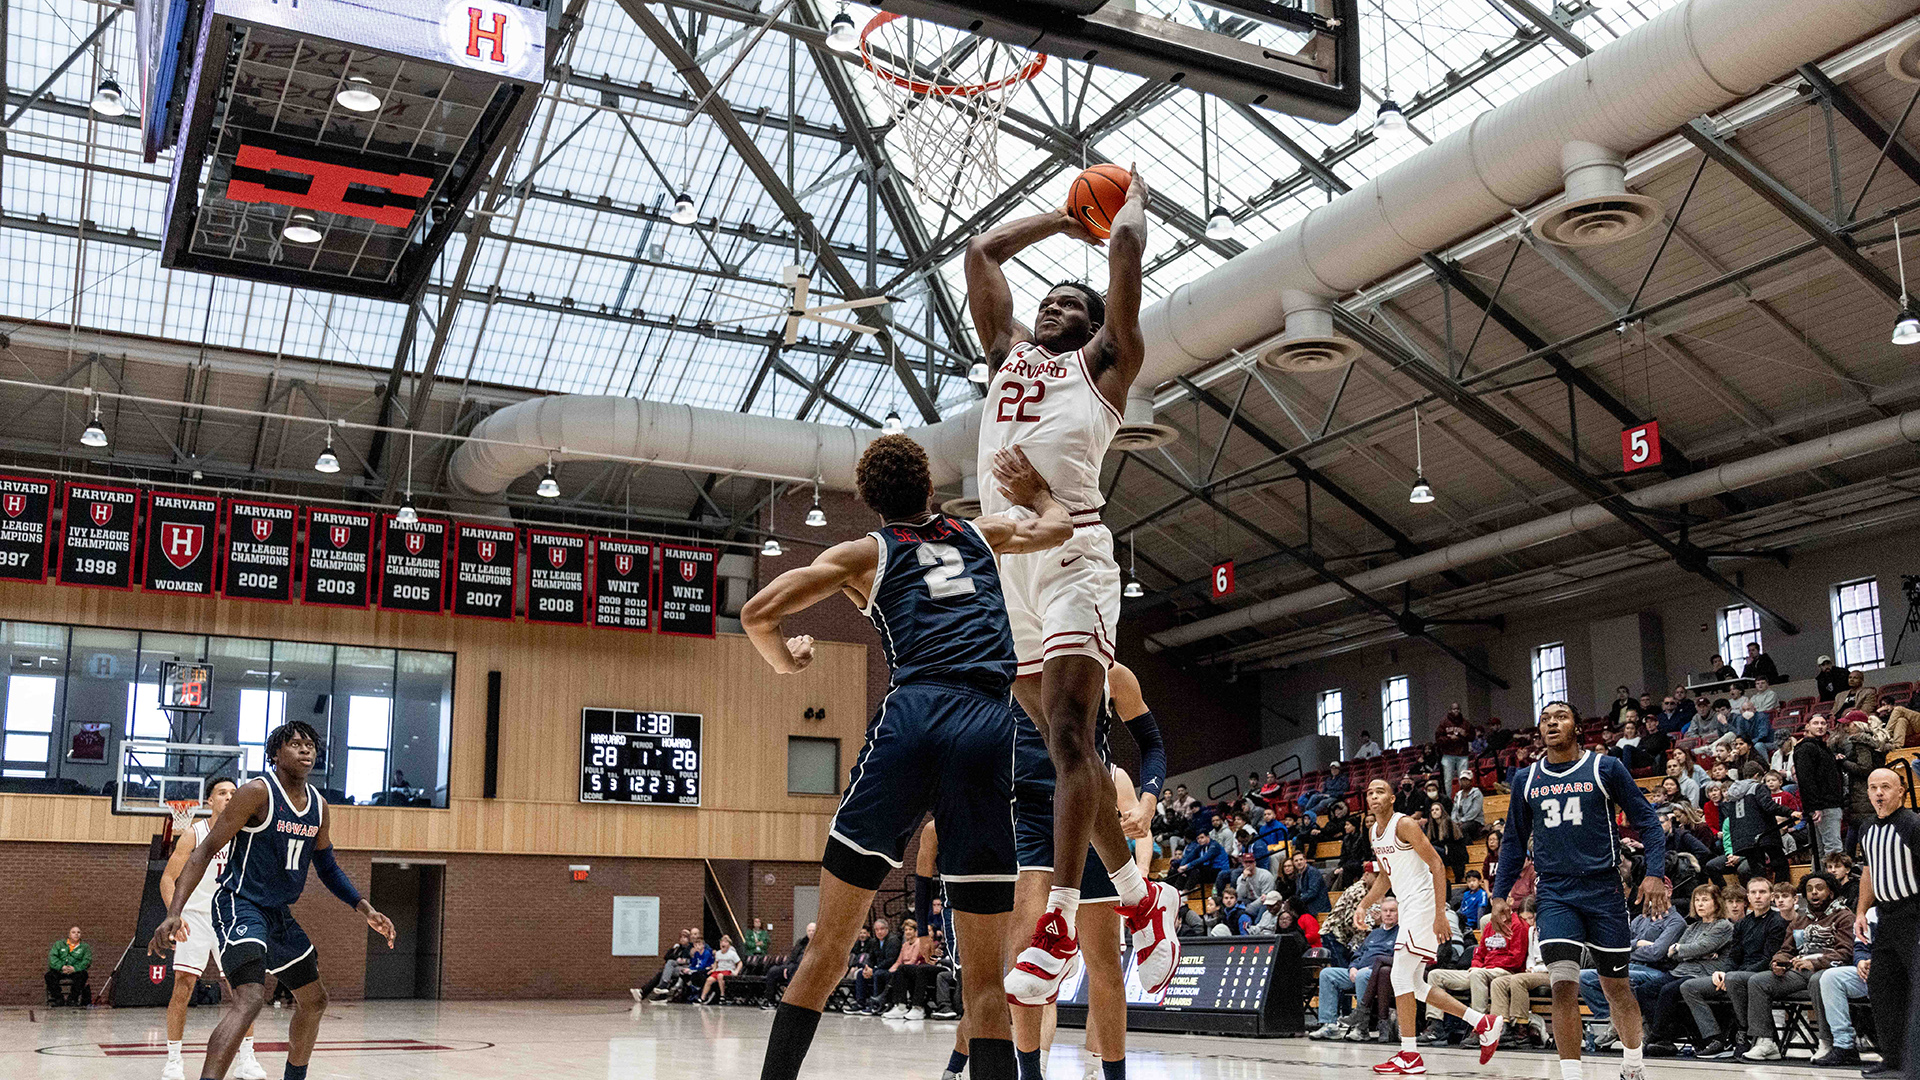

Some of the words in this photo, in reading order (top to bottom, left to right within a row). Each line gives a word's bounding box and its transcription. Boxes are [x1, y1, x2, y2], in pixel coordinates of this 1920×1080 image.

[466, 7, 506, 63] H
[996, 380, 1046, 423] 22
[1631, 428, 1649, 463] 5
[0, 481, 48, 494] RVARD
[72, 487, 134, 503] HARVARD
[8, 496, 21, 511] H
[96, 503, 108, 518] H
[155, 496, 215, 512] HARVARD
[234, 505, 292, 520] HARVARD
[314, 512, 368, 527] HARVARD
[2, 520, 43, 533] LEAGUE
[70, 526, 89, 538] IVY
[91, 528, 130, 542] LEAGUE
[256, 521, 269, 536] H
[389, 520, 443, 534] HARVARD
[171, 527, 194, 556] H
[335, 528, 346, 543] H
[410, 535, 420, 550] H
[462, 528, 514, 542] HARVARD
[533, 534, 584, 548] HARVARD
[68, 537, 129, 552] CHAMPIONS
[232, 542, 250, 554] IVY
[252, 544, 289, 556] LEAGUE
[482, 543, 492, 557] H
[600, 542, 648, 555] HARVARD
[231, 552, 289, 566] CHAMPIONS
[311, 548, 328, 559] IVY
[330, 551, 366, 563] LEAGUE
[388, 554, 404, 565] IVY
[405, 558, 440, 569] LEAGUE
[553, 550, 562, 563] H
[665, 548, 712, 562] HARVARD
[76, 557, 117, 575] 1998
[310, 558, 366, 573] CHAMPIONS
[460, 562, 476, 572] IVY
[478, 564, 512, 577] LEAGUE
[620, 556, 629, 570] H
[684, 562, 694, 576] H
[386, 565, 440, 579] CHAMPIONS
[532, 569, 548, 579] IVY
[550, 570, 582, 582] LEAGUE
[916, 542, 976, 600] 2
[155, 579, 203, 593] WOMEN
[238, 573, 278, 590] 2002
[317, 578, 356, 595] 2003
[459, 572, 512, 586] CHAMPIONS
[532, 578, 582, 592] CHAMPIONS
[607, 579, 640, 594] WNIT
[1616, 567, 1628, 592] 6
[393, 584, 430, 600] 2005
[466, 591, 502, 608] 2007
[672, 585, 704, 600] WNIT
[539, 598, 574, 612] 2008
[598, 614, 620, 625] 2014
[636, 714, 671, 734] 1:38
[590, 734, 626, 746] HARVARD
[662, 738, 692, 749] HOWARD
[592, 746, 618, 766] 28
[643, 751, 648, 766] 1
[672, 750, 697, 770] 28
[584, 766, 604, 774] FOULS
[624, 768, 646, 776] PLAYER
[647, 769, 662, 777] FOUL
[679, 771, 698, 779] FOULS
[591, 774, 602, 790] 5
[610, 778, 618, 790] 3
[630, 776, 645, 792] 12
[649, 776, 660, 793] 2
[667, 780, 675, 793] 3
[686, 778, 696, 794] 5
[1530, 782, 1594, 798] HOWARD
[631, 794, 652, 802] MATCH
[1540, 796, 1584, 828] 34
[285, 838, 305, 870] 11
[1228, 946, 1234, 954] P
[1241, 946, 1248, 954] R
[1254, 946, 1260, 954] A
[1268, 946, 1274, 954] F
[1182, 956, 1204, 964] SETTLE
[1226, 956, 1232, 965] 0
[1238, 956, 1245, 965] 2
[1252, 956, 1258, 965] 0
[1266, 956, 1272, 965] 0
[152, 966, 163, 980] H
[1223, 967, 1230, 976] 2
[1262, 967, 1268, 976] 2
[1220, 978, 1226, 986] 0
[1233, 978, 1239, 986] 0
[1246, 978, 1252, 986] 0
[1260, 978, 1266, 986] 0
[1217, 988, 1223, 997] 2
[1231, 989, 1236, 997] 1
[1244, 989, 1248, 997] 1
[1256, 990, 1262, 998] 2
[1214, 999, 1220, 1008] 5
[1226, 1000, 1232, 1008] 2
[1240, 1000, 1246, 1008] 0
[1254, 1000, 1260, 1008] 0
